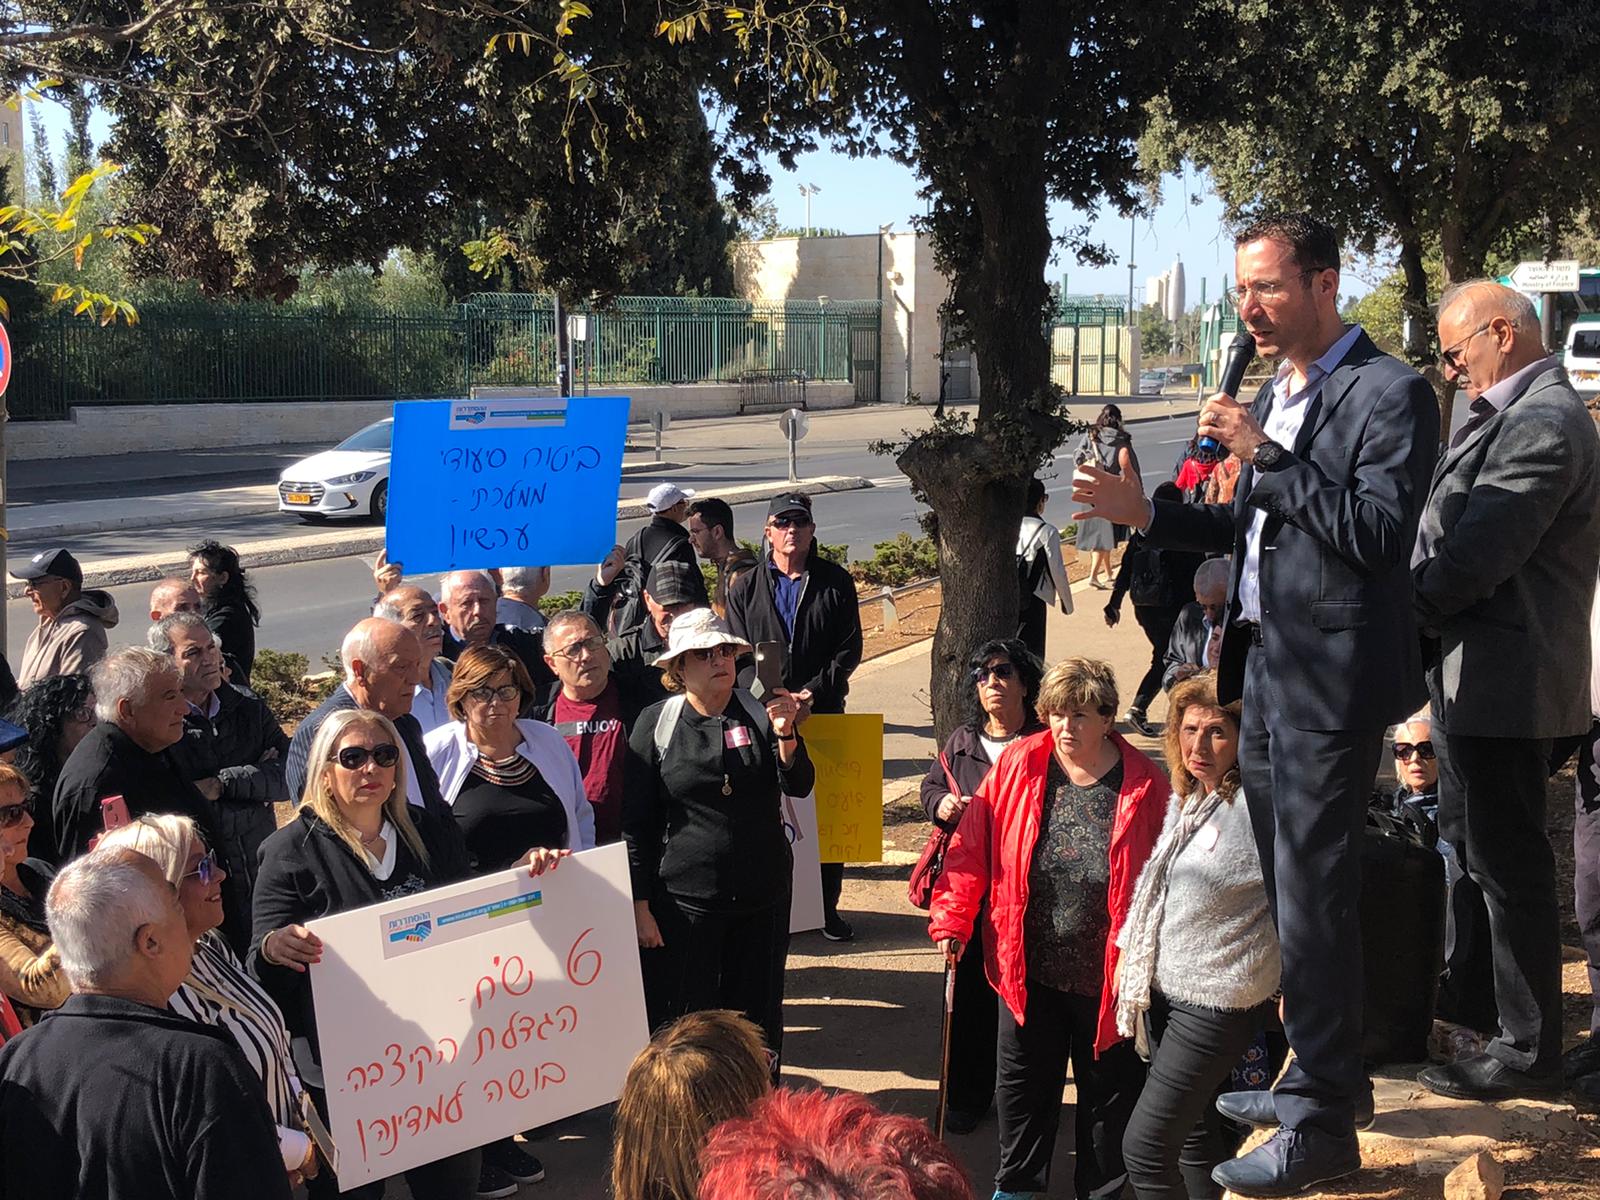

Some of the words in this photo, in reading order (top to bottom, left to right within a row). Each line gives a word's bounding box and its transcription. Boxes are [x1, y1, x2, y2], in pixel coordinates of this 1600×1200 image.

[440, 447, 507, 474] סיעודי
[523, 445, 601, 473] ביטוח
[469, 479, 548, 512] ממלכתי
[576, 719, 618, 735] ENJOY
[472, 1004, 580, 1065] הגדלת
[482, 1061, 568, 1103] בושה
